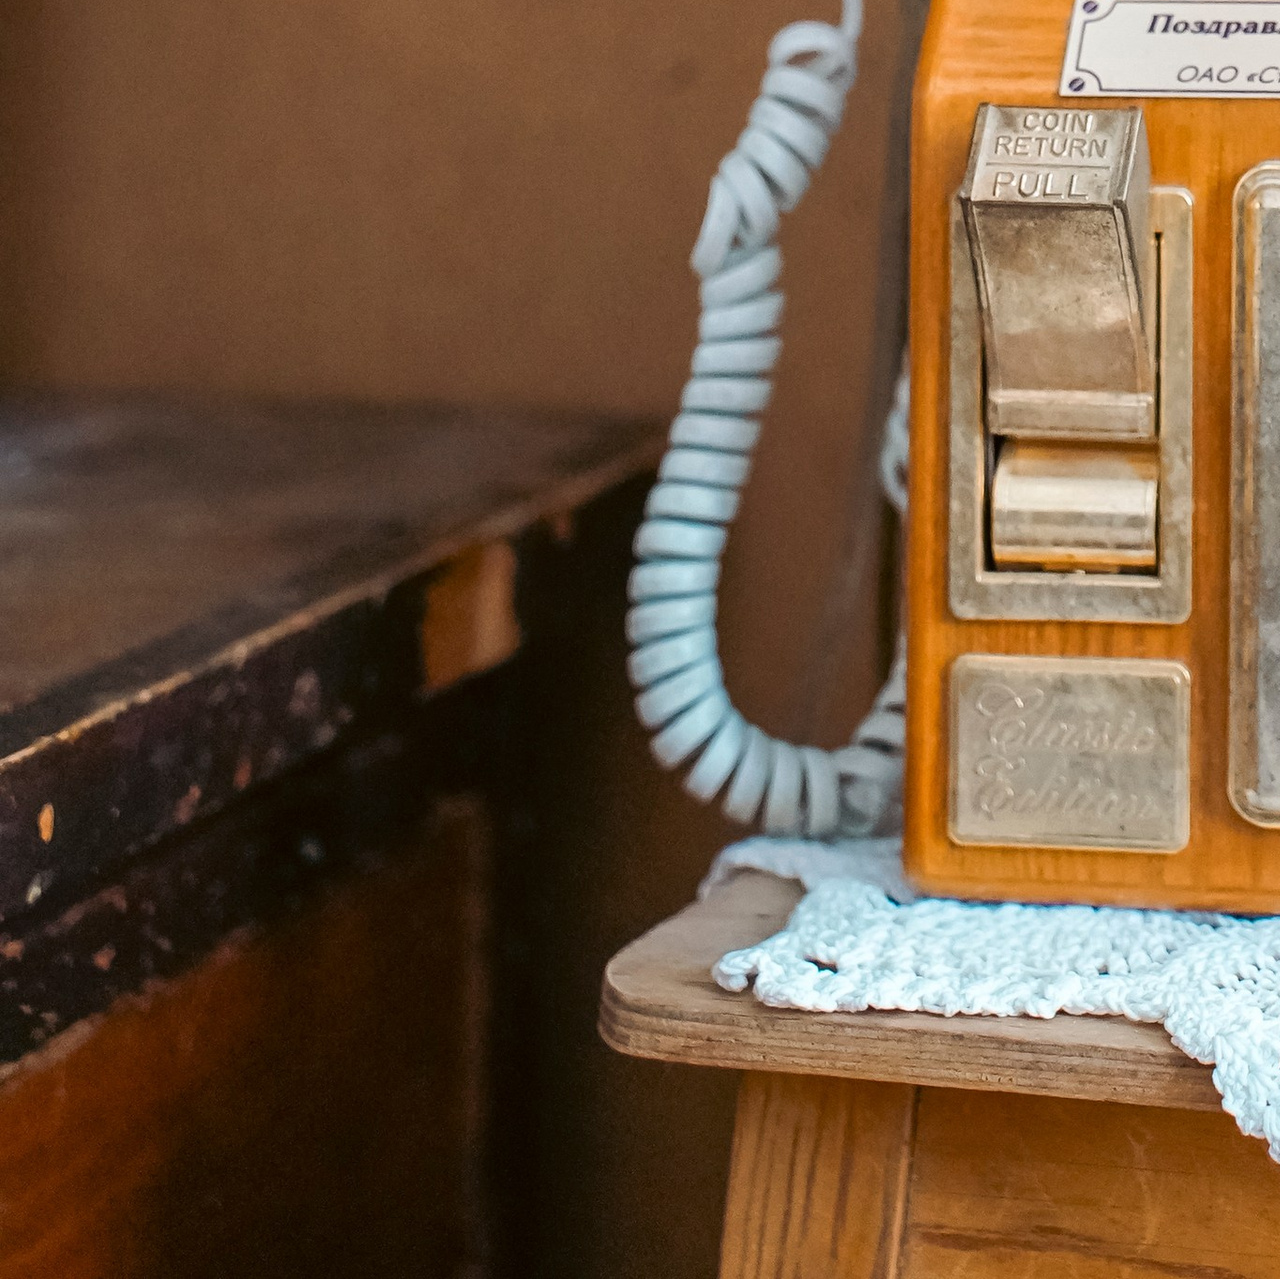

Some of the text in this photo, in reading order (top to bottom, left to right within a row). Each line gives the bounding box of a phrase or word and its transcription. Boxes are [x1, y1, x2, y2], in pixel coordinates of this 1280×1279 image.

[1176, 65, 1239, 84] ОАО
[1023, 111, 1095, 135] COIN
[994, 134, 1107, 160] RETURN
[992, 170, 1090, 201] PULL
